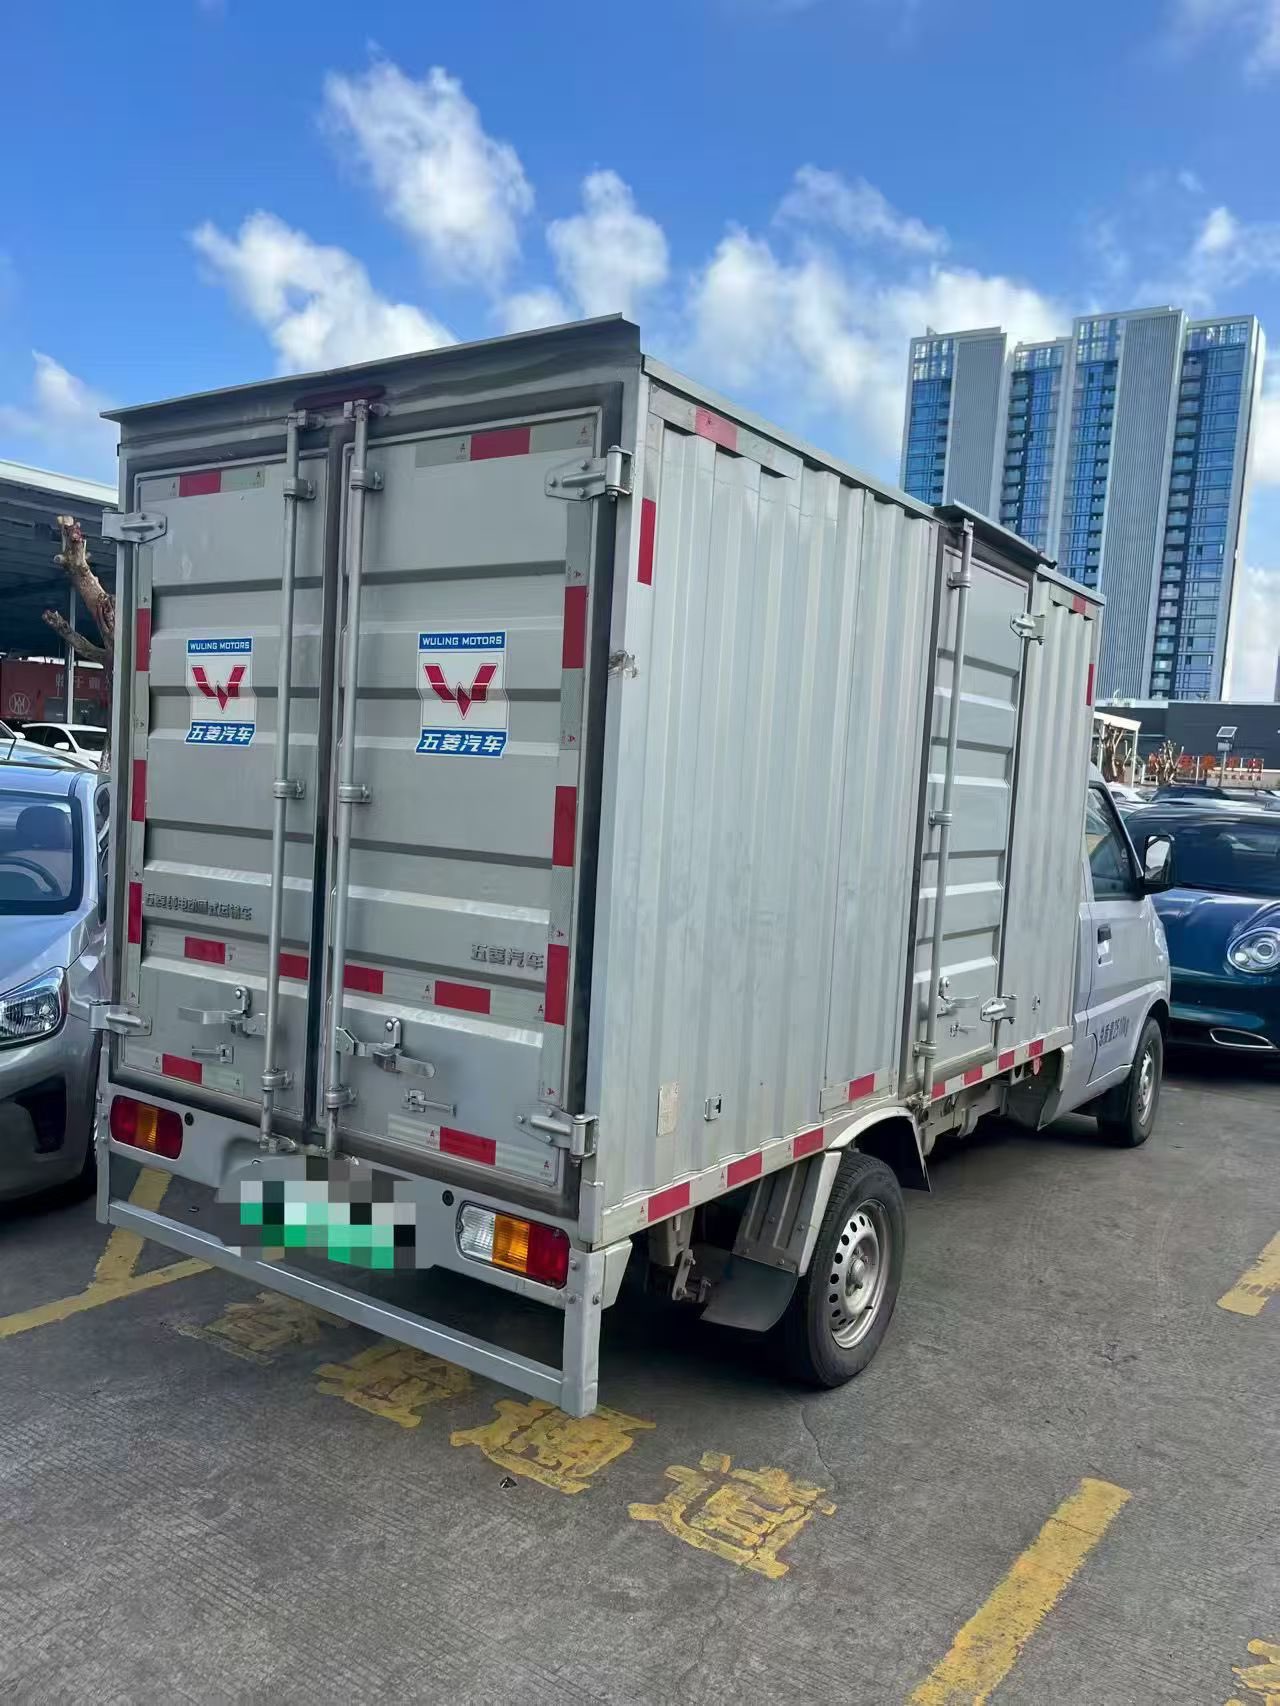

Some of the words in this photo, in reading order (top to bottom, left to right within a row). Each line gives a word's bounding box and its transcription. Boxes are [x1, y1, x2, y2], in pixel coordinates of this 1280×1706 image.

[190, 642, 217, 650] WULING
[219, 641, 250, 650] MOTORS
[422, 637, 459, 646] WULING
[462, 635, 503, 645] MOTORS
[190, 724, 253, 743] 五菱汽车
[419, 733, 502, 753] 五菱汽车
[471, 944, 544, 969] 五菱汽车
